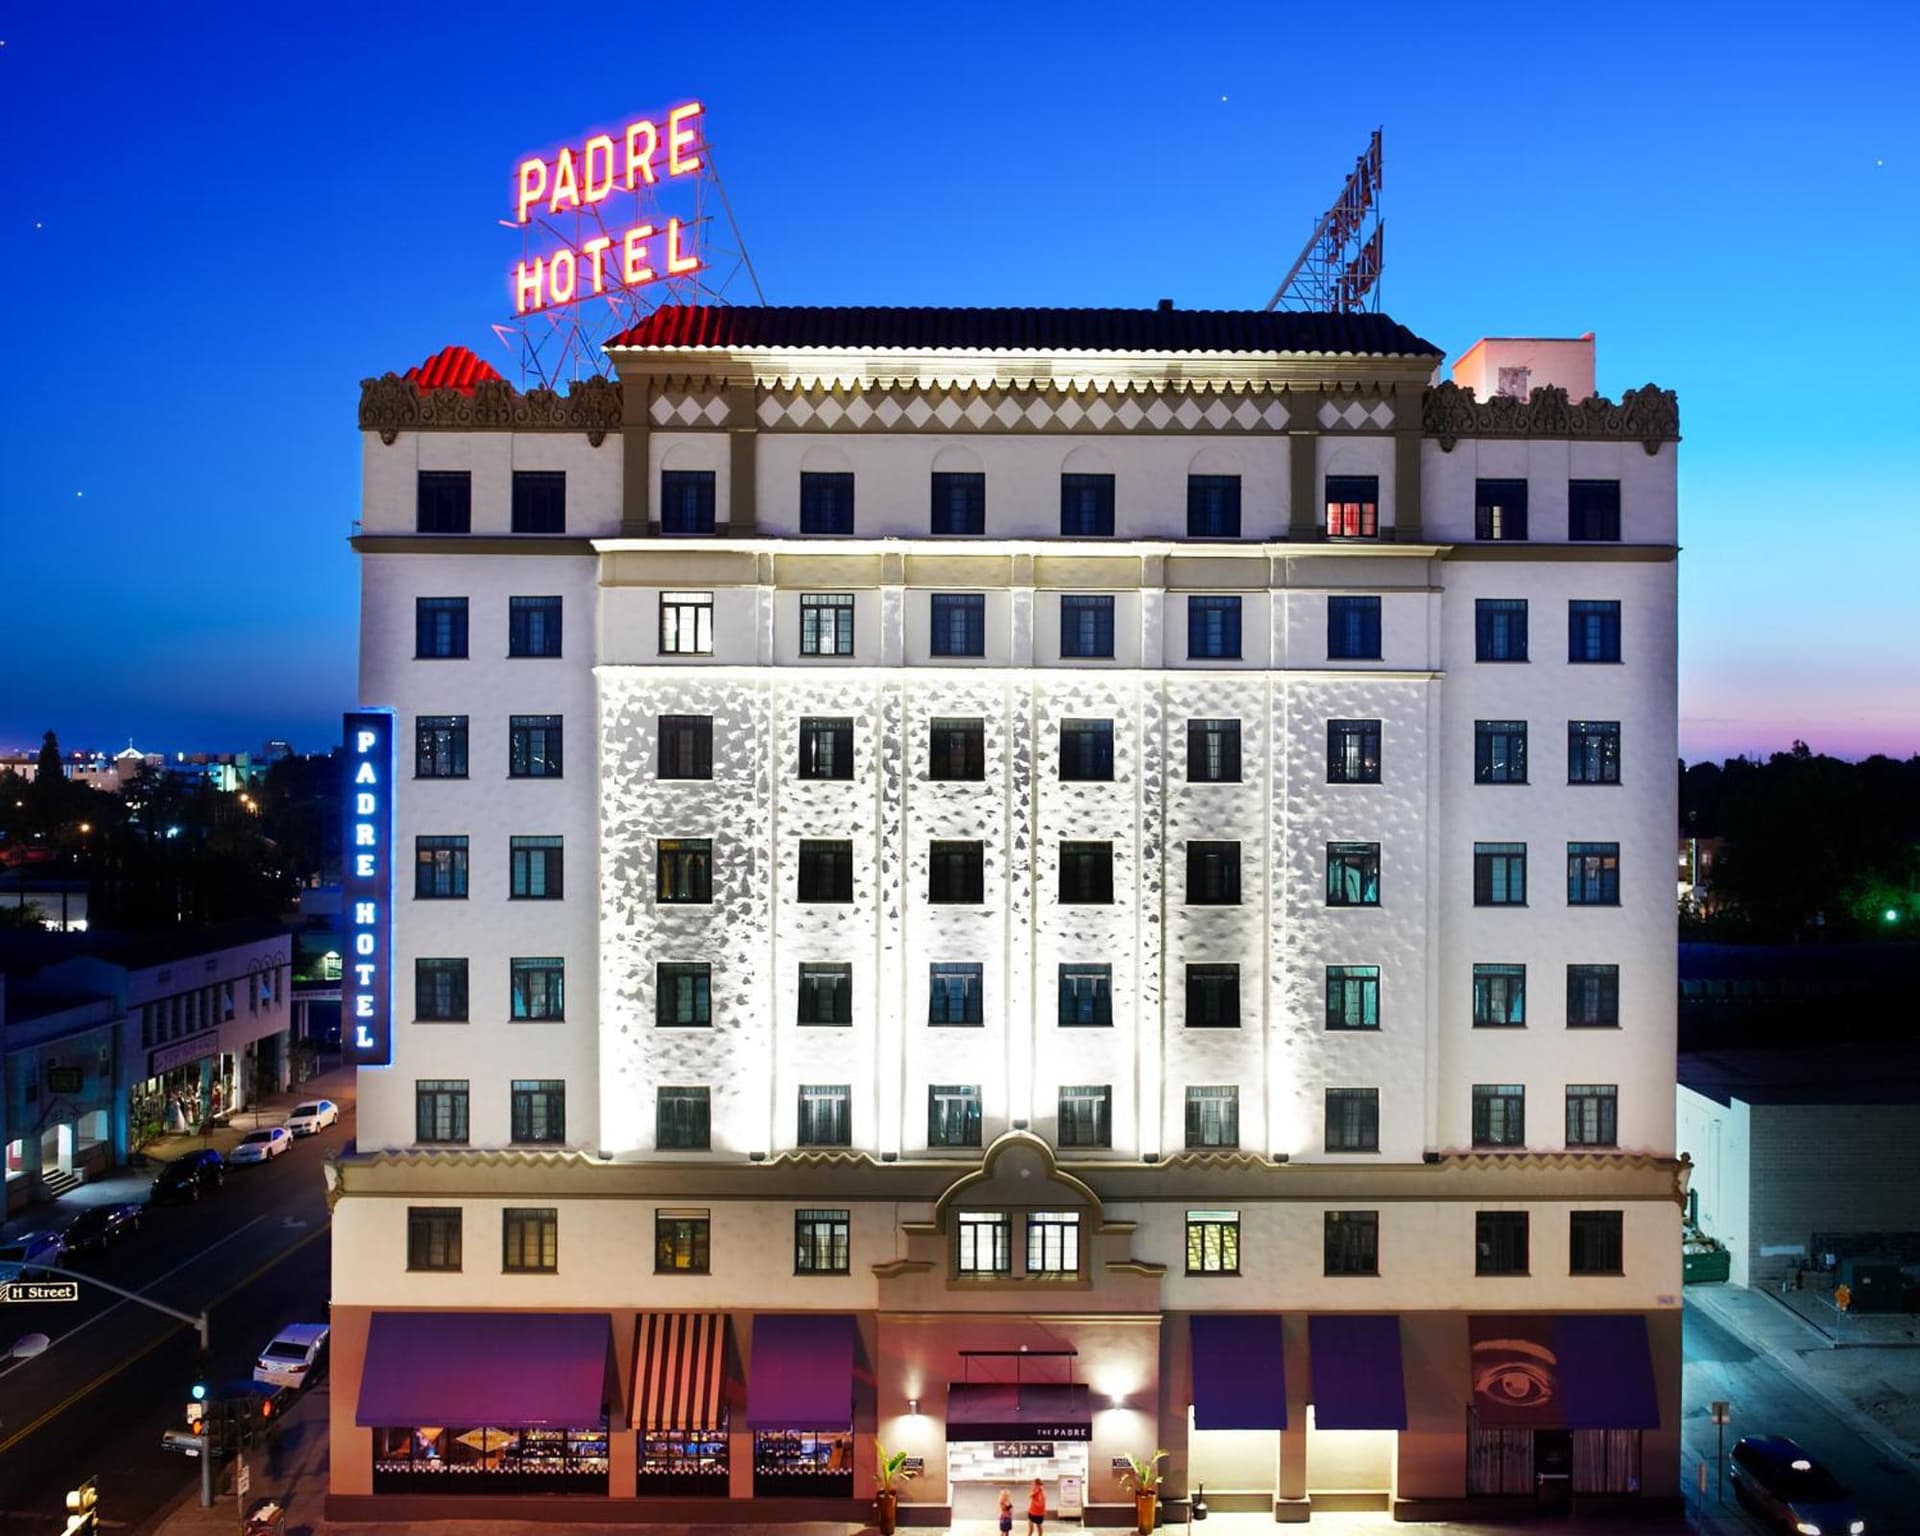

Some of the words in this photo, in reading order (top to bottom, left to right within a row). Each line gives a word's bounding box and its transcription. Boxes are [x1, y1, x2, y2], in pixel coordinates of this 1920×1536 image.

[518, 102, 701, 224] PADRE
[517, 217, 698, 313] HOTEL
[355, 731, 377, 876] PADRE
[355, 903, 376, 1048] HOTEL
[12, 1287, 23, 1298] H
[28, 1286, 72, 1298] Street
[1037, 1428, 1051, 1436] THE
[1053, 1428, 1086, 1437] PADRE
